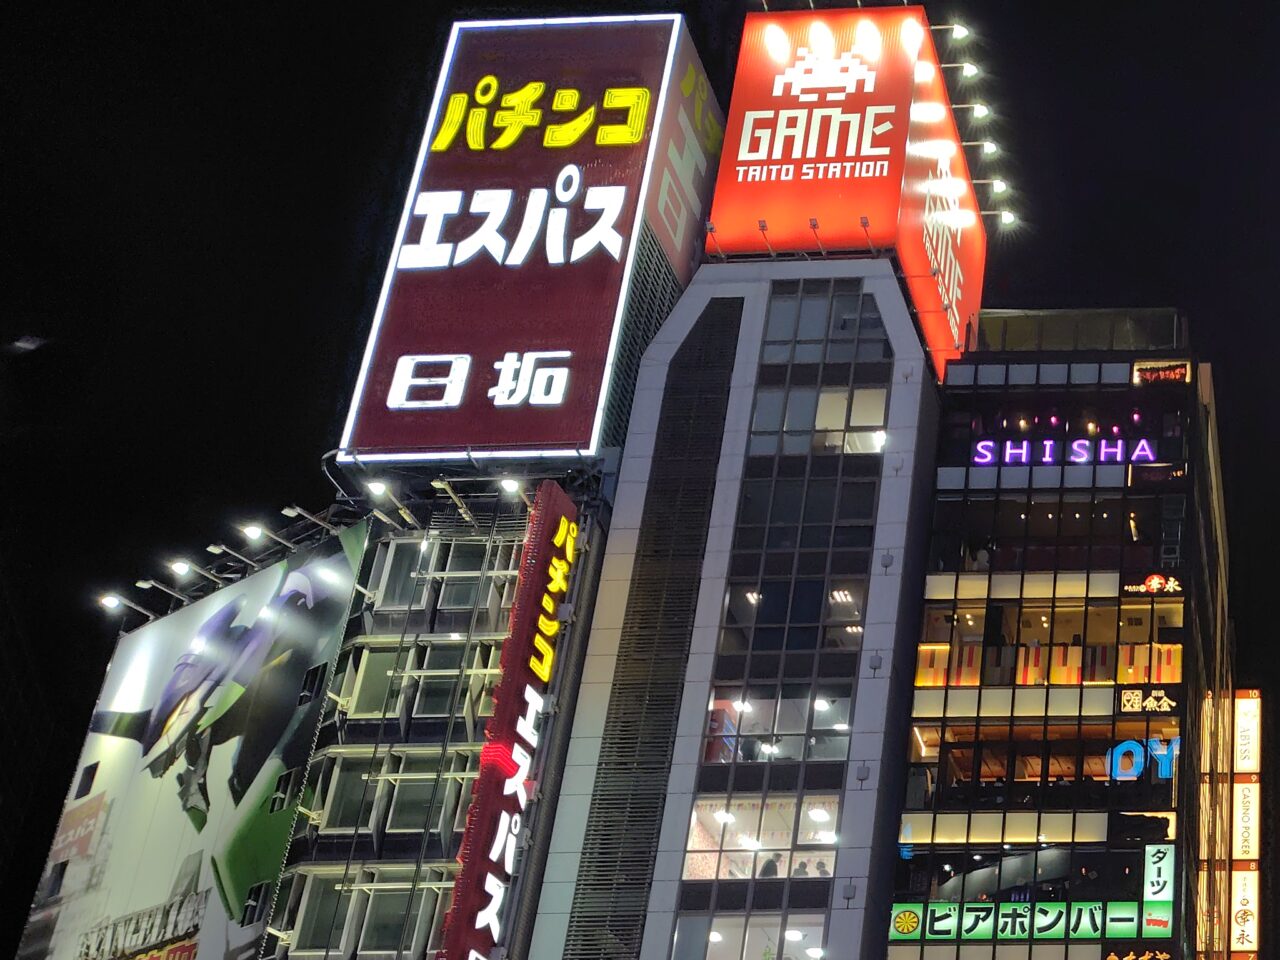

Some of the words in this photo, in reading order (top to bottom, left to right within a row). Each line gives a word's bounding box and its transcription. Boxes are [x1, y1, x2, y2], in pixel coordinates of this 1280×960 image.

[431, 74, 650, 152] パチンコ
[737, 105, 896, 161] GAME
[735, 164, 793, 183] TAITO
[800, 161, 888, 180] STATION
[398, 164, 627, 270] エスパス
[385, 350, 573, 410] 日拓
[973, 438, 1156, 464] SHISHA
[529, 514, 578, 684] パチンコ
[1248, 690, 1258, 699] 10
[1250, 774, 1257, 783] 9
[474, 682, 545, 944] エスパス
[1241, 787, 1251, 823] CASINO
[1241, 825, 1251, 856] POKER
[1150, 847, 1169, 896] ダーツ
[1249, 861, 1256, 870] 8
[927, 905, 1136, 937] ビアポンバー
